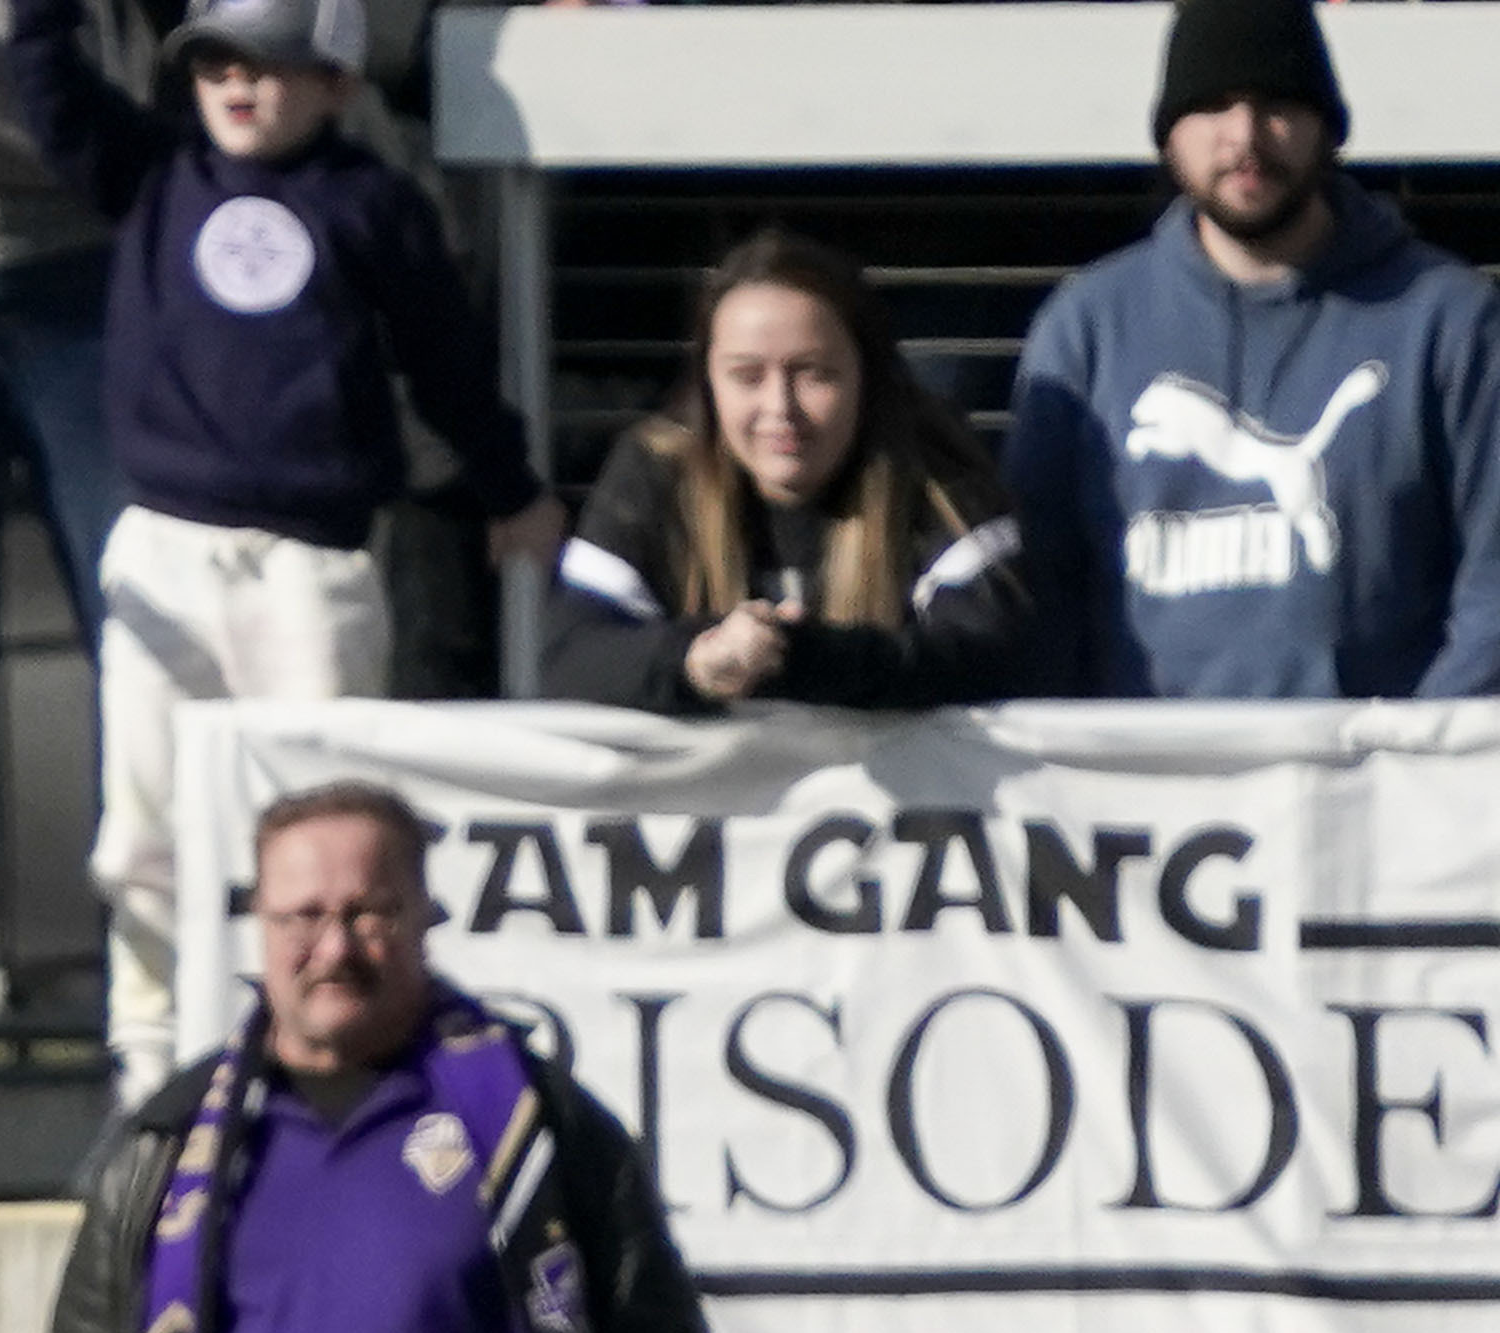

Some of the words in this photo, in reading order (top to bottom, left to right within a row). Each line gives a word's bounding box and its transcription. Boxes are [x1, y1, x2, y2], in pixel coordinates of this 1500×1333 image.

[422, 816, 724, 940] AM
[784, 809, 1262, 951] GANG
[475, 985, 1500, 1218] ISODE
